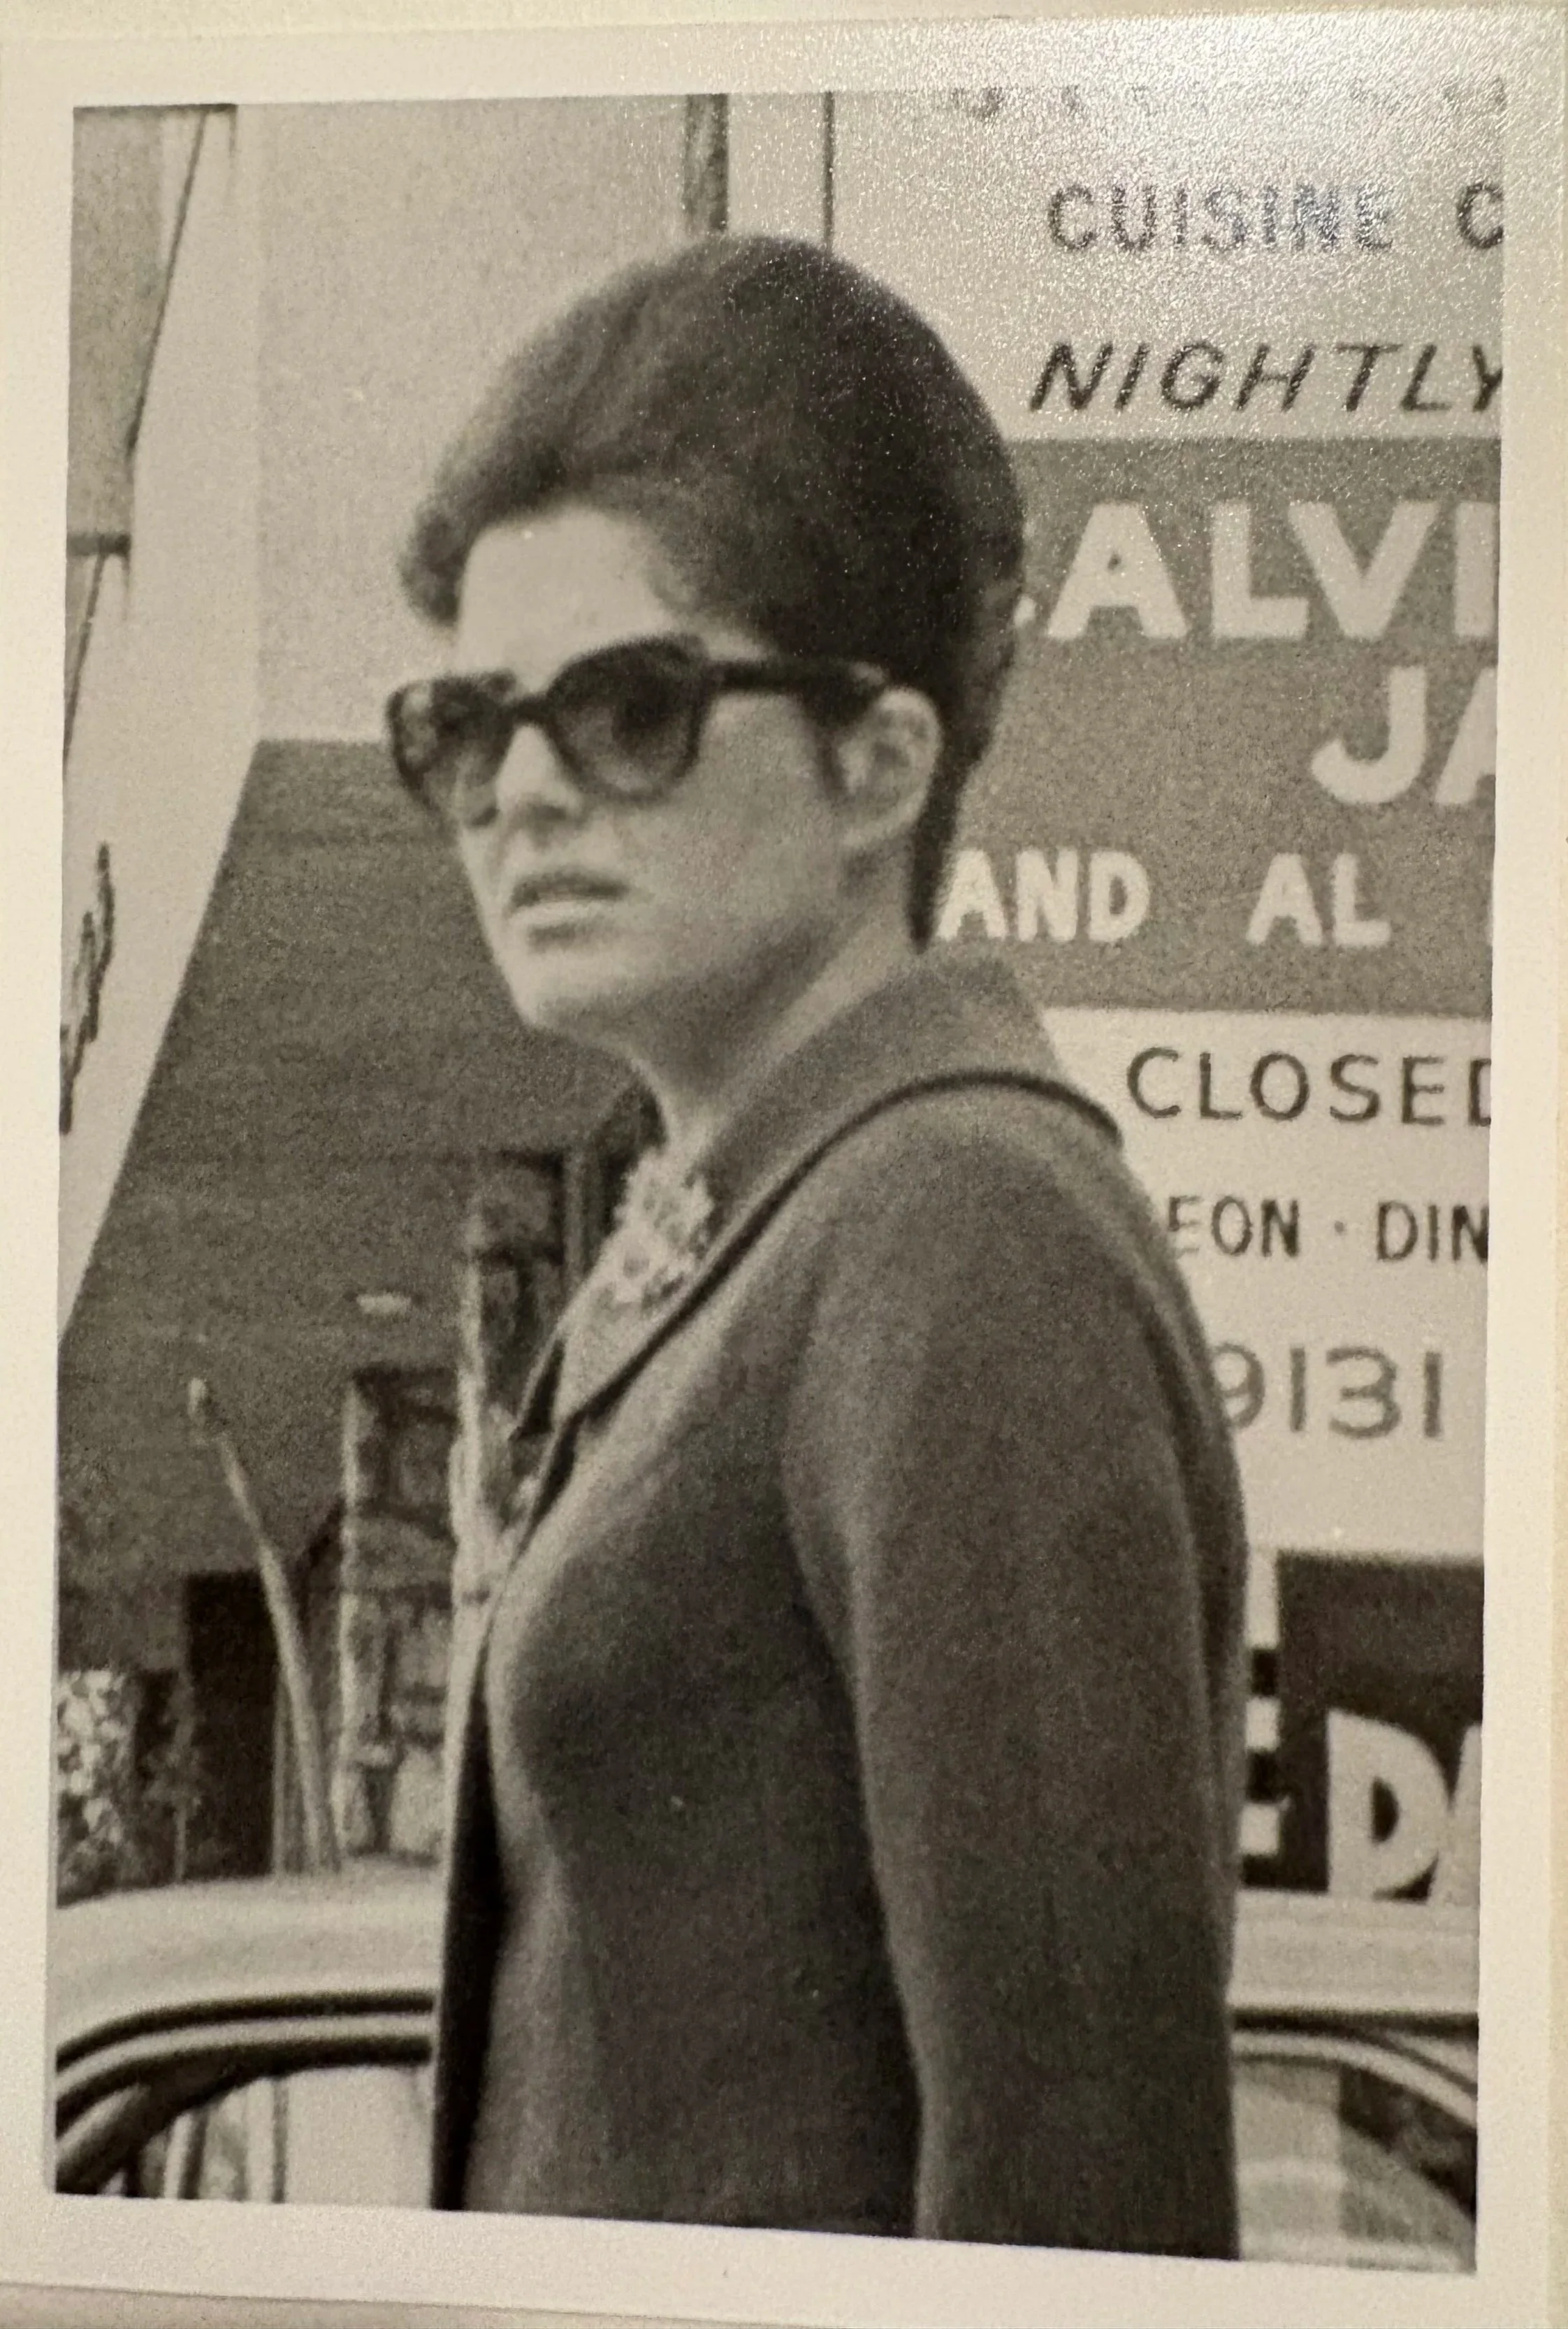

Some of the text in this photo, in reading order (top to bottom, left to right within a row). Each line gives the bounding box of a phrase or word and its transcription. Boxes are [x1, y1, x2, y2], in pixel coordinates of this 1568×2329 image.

[1047, 183, 1392, 252] CUISINE
[1029, 342, 1502, 412] NIGHTLY
[935, 848, 1391, 948] AND AL
[1213, 1342, 1444, 1439] 9131
